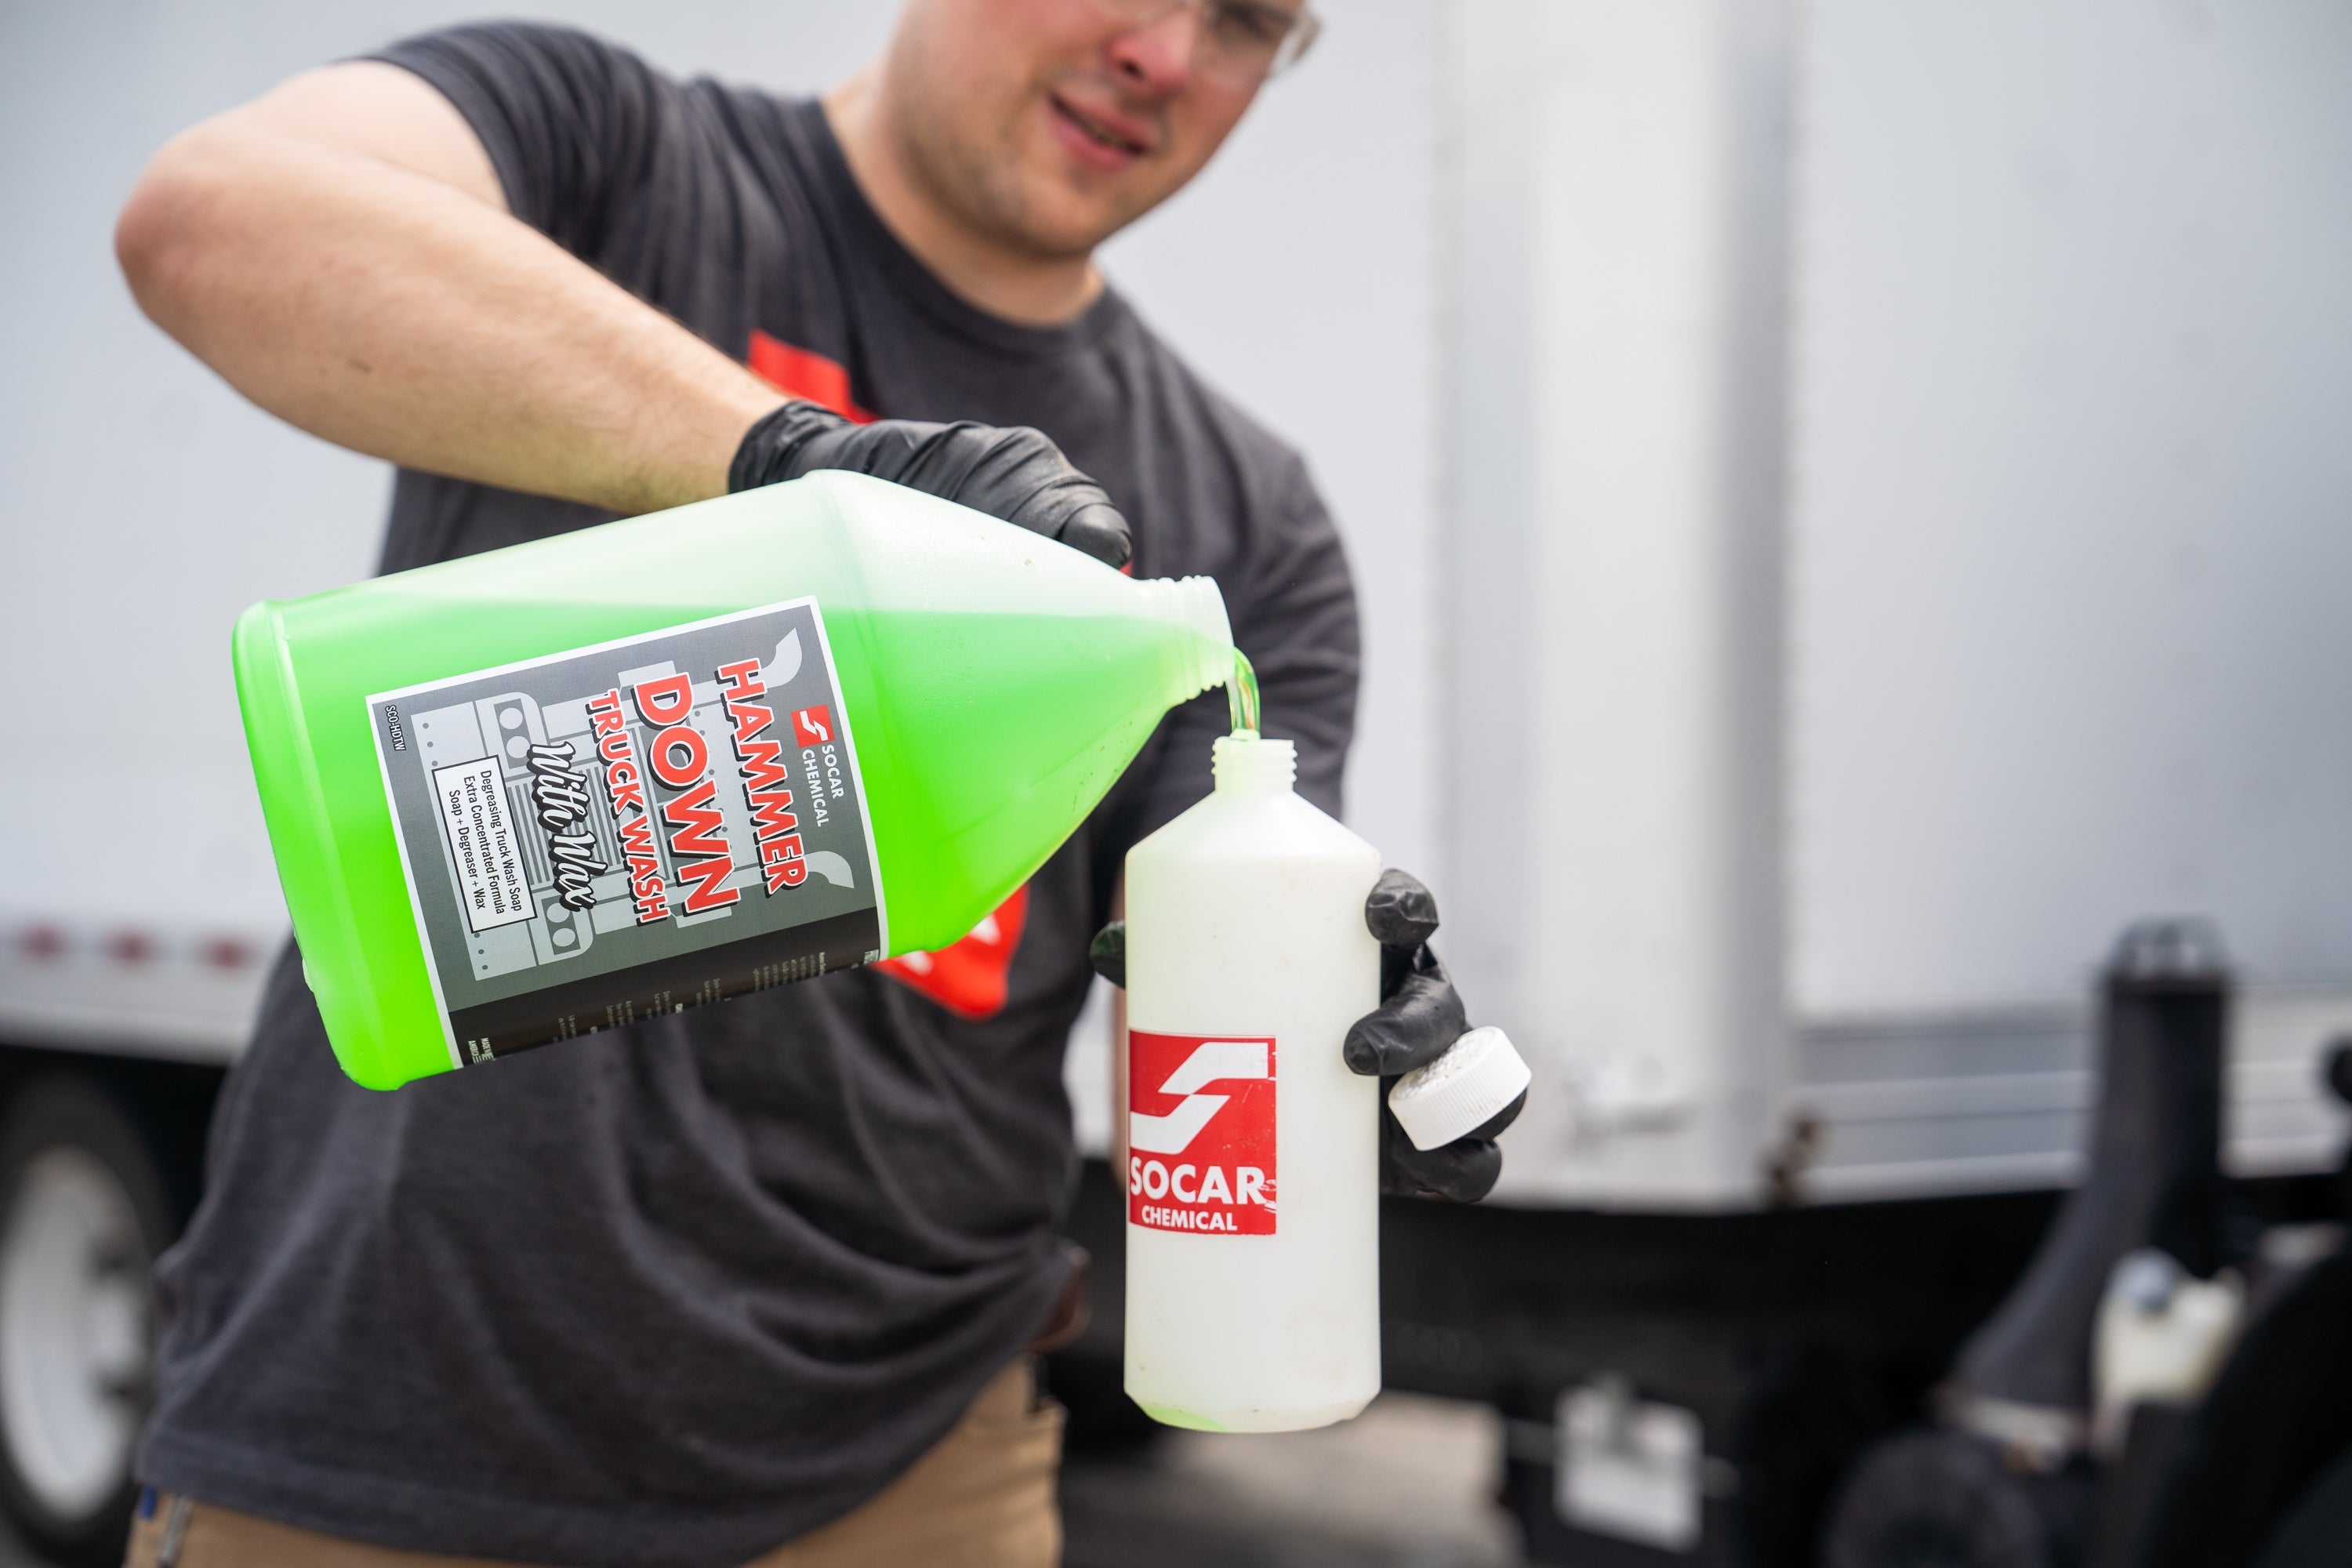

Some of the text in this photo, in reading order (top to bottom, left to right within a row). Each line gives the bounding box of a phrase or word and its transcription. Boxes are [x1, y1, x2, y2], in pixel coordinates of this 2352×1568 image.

[385, 704, 406, 752] SCO-HDTW
[633, 671, 742, 913] DOWN
[717, 657, 809, 896] HAMMER
[801, 748, 829, 827] CHEMICAL
[821, 744, 844, 800] SOCAR
[448, 789, 463, 817] Soap
[457, 827, 477, 880] Degreaser
[473, 888, 486, 910] Wax
[463, 775, 505, 915] Extra Concentrated Formula
[480, 769, 523, 912] Degreasing Truck Wash Soap
[530, 742, 608, 909] With Wax
[588, 688, 671, 924] TRUCK WASH
[1130, 1156, 1266, 1205] SOCAR
[1142, 1205, 1237, 1232] CHEMICAL
